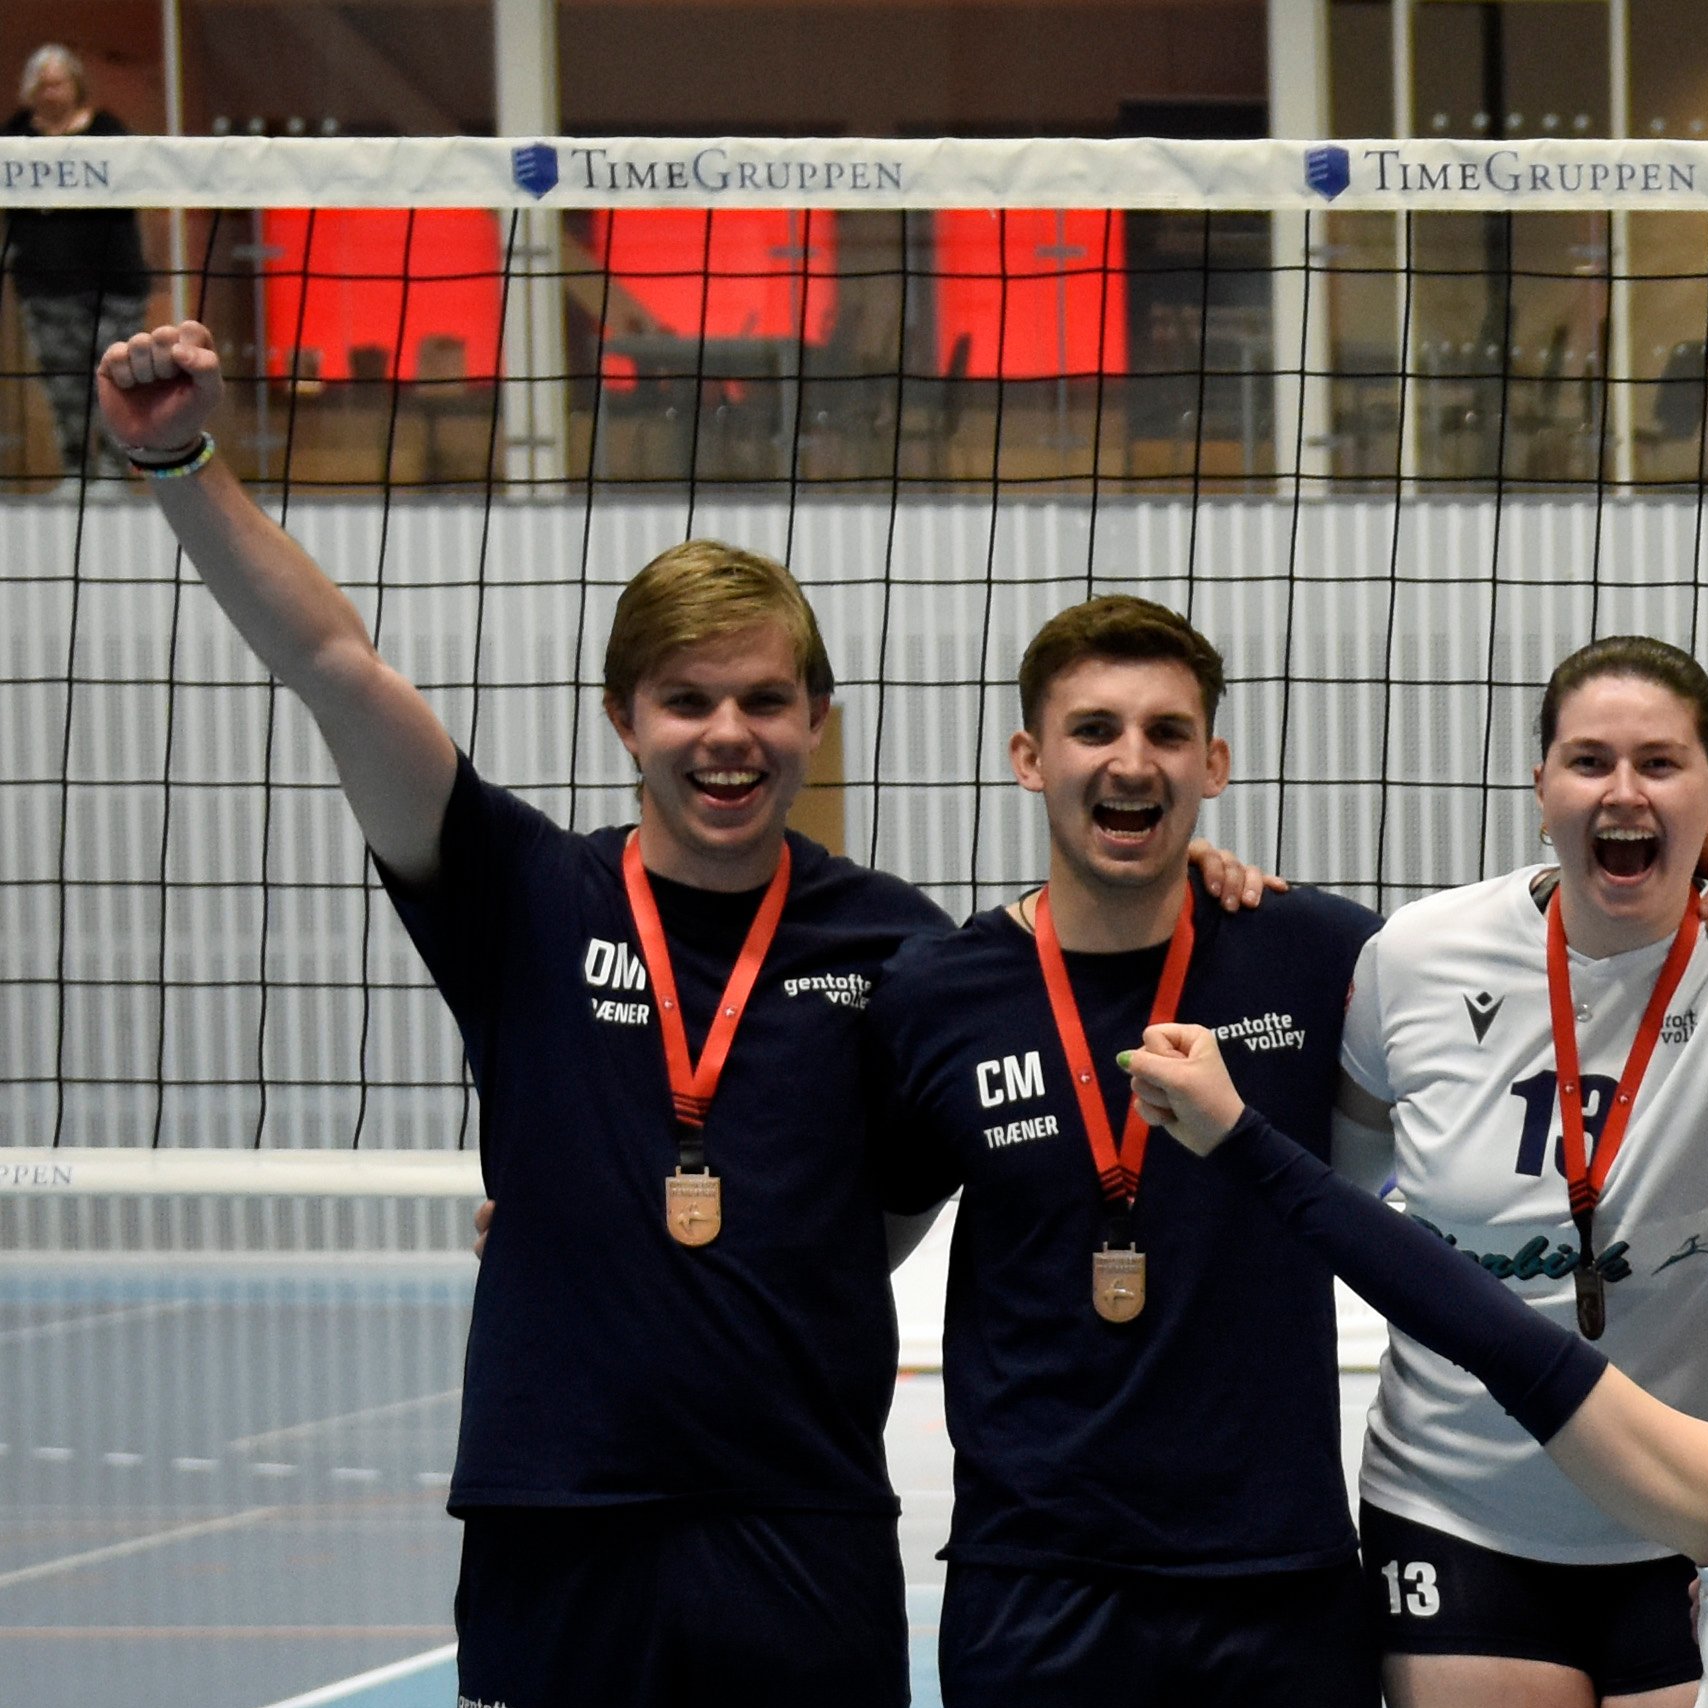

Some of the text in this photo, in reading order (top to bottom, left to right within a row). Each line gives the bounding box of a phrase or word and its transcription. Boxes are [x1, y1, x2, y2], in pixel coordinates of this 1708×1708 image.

[591, 998, 650, 1025] ÆNER
[825, 988, 869, 1010] volle
[1211, 1012, 1292, 1040] entofte
[1244, 1029, 1306, 1051] volley
[976, 1051, 1045, 1108] CM
[983, 1115, 1060, 1149] TRÆNER
[1510, 1069, 1620, 1181] 13
[1381, 1560, 1441, 1617] 13
